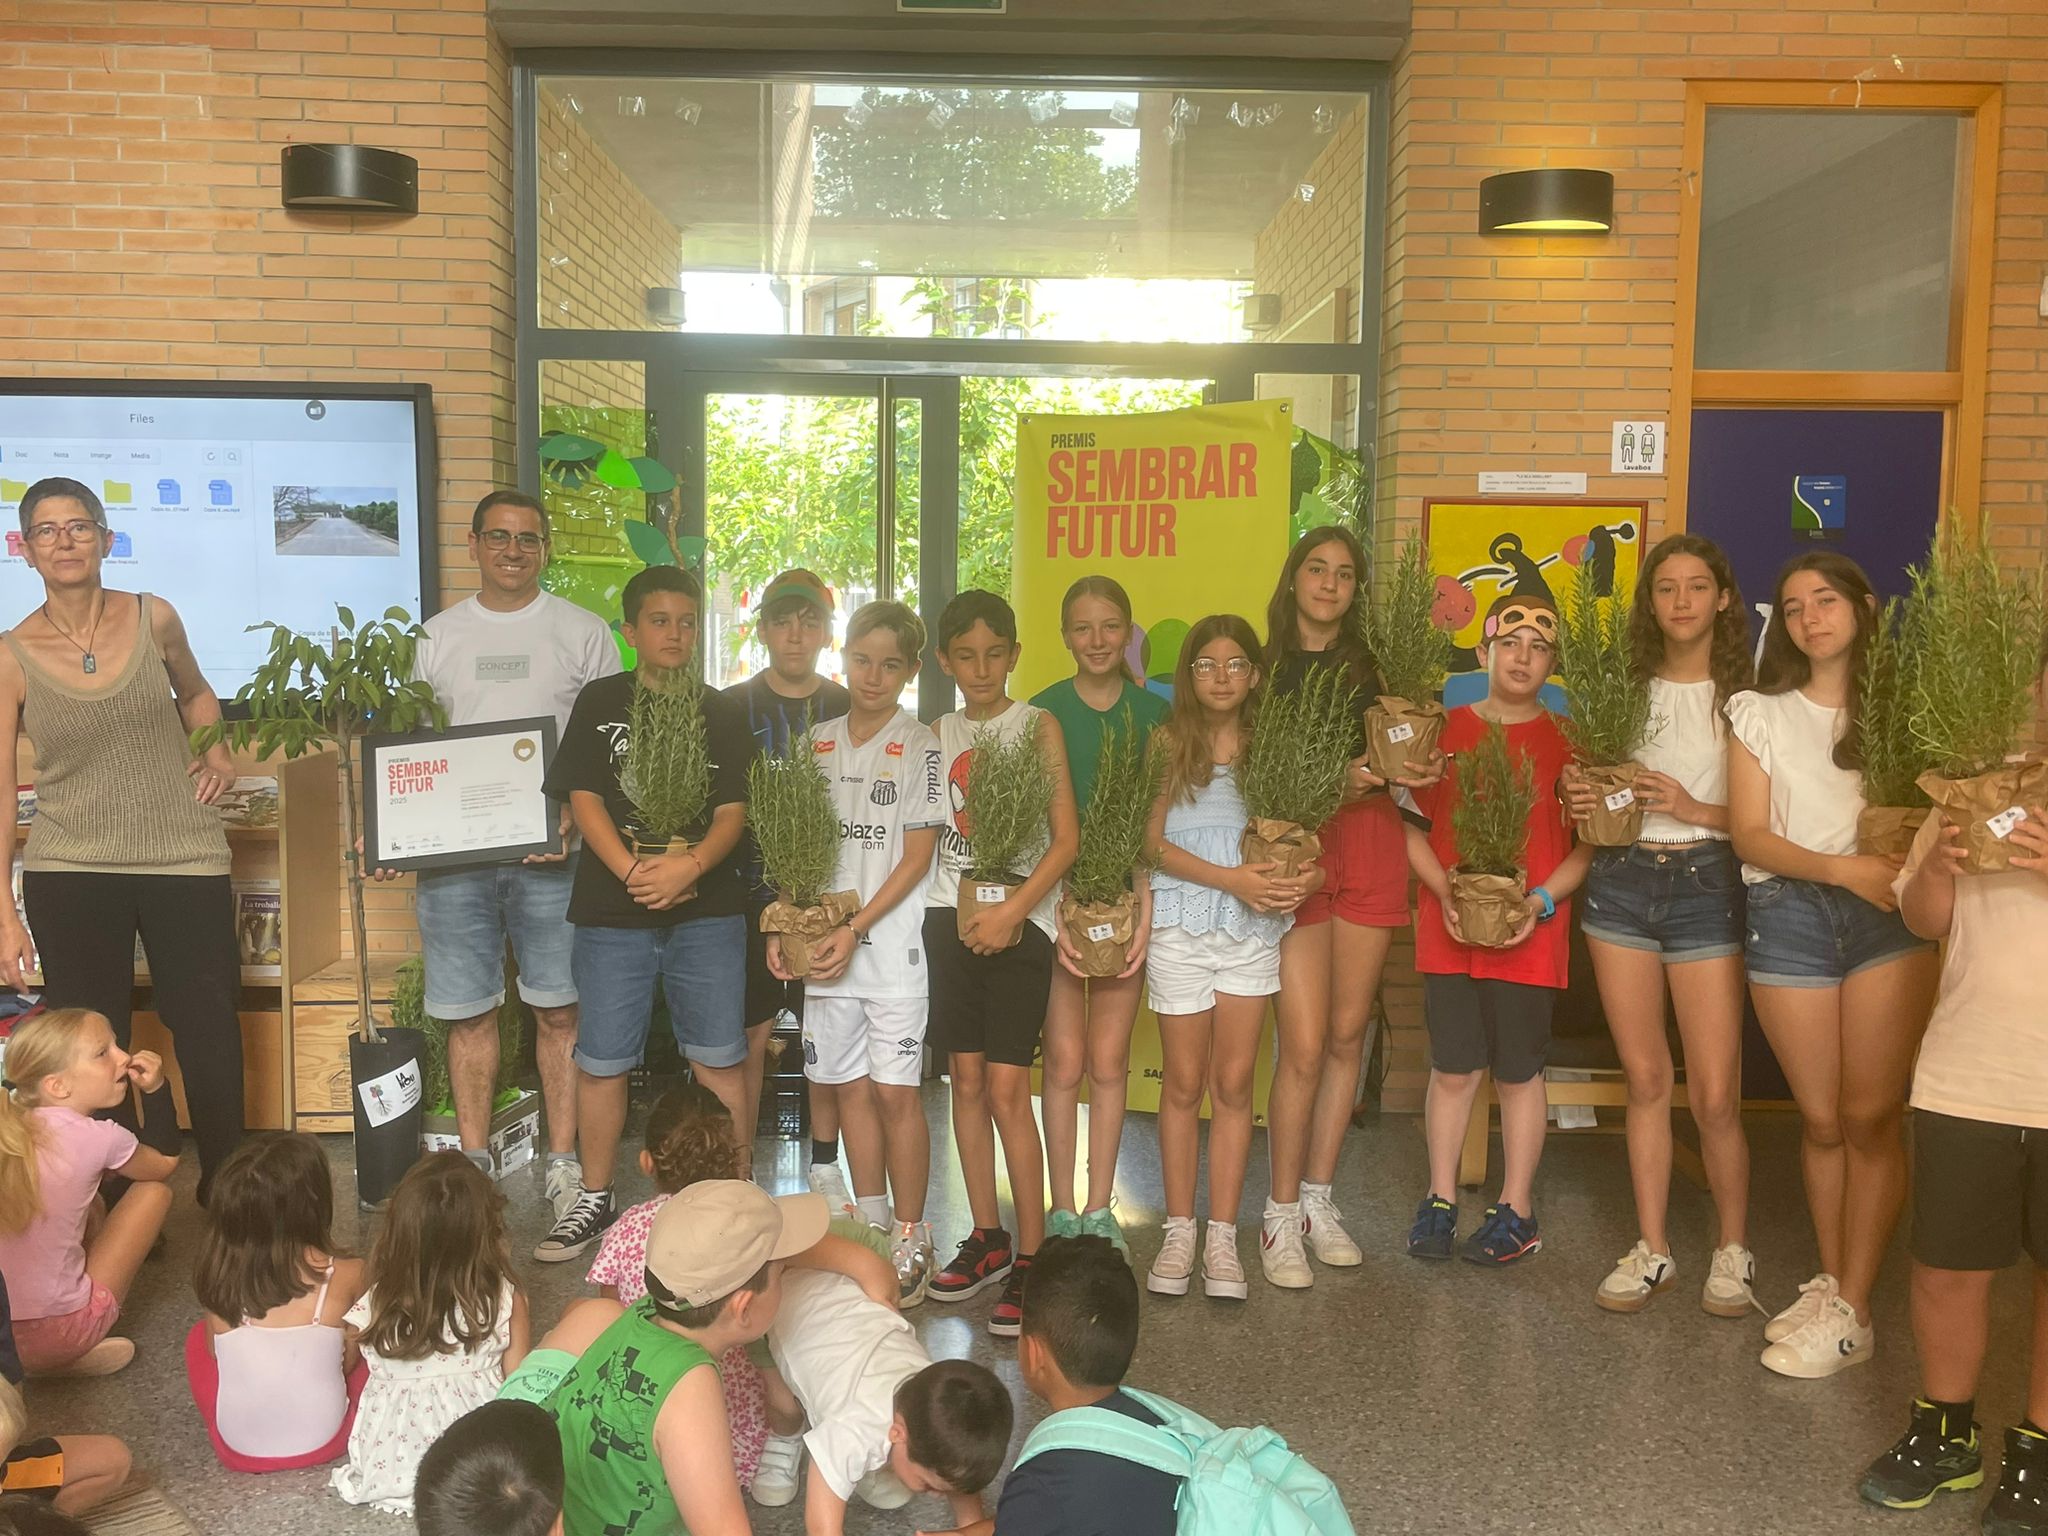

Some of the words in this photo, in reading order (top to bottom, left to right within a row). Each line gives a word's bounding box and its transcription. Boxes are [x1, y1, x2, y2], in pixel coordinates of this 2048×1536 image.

[130, 413, 154, 424] Files
[1051, 432, 1096, 448] PREMIS
[1047, 442, 1258, 503] SEMBRAR
[1046, 503, 1177, 558] FUTUR
[478, 661, 528, 672] CONCEPT
[388, 759, 448, 780] SEMBRAR
[389, 776, 433, 796] FUTUR
[390, 797, 408, 805] 2025
[839, 821, 886, 840] blaze
[395, 1072, 406, 1082] LA
[399, 1073, 415, 1090] NOU
